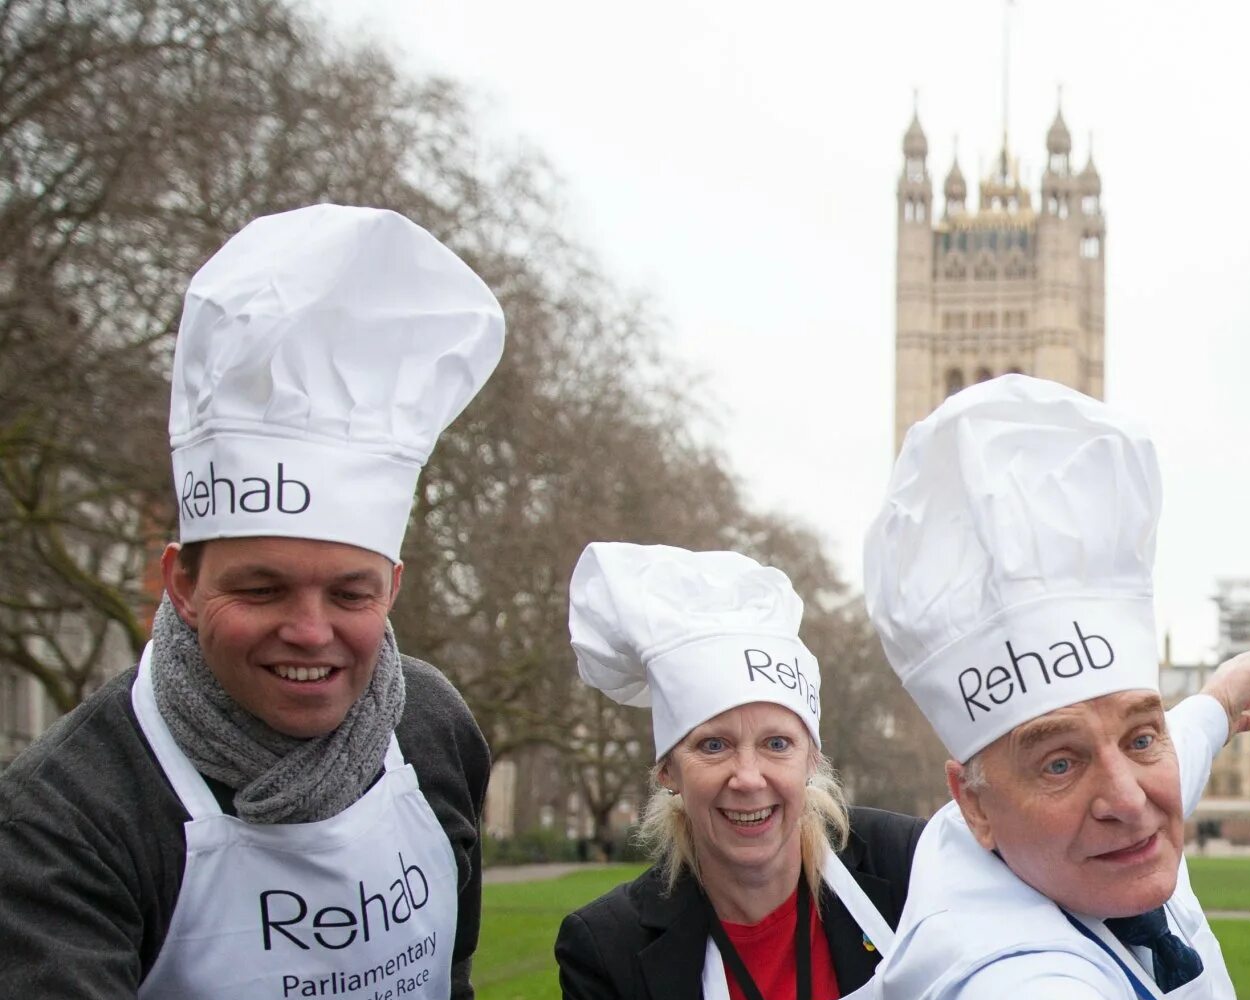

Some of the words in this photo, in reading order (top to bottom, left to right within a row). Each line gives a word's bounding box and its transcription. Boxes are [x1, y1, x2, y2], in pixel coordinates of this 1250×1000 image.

[181, 461, 311, 520] Rehab
[744, 648, 819, 715] Reha
[958, 621, 1114, 722] Rehab
[259, 851, 430, 951] Rehab
[282, 931, 437, 998] Parliamentary
[397, 968, 430, 997] Race
